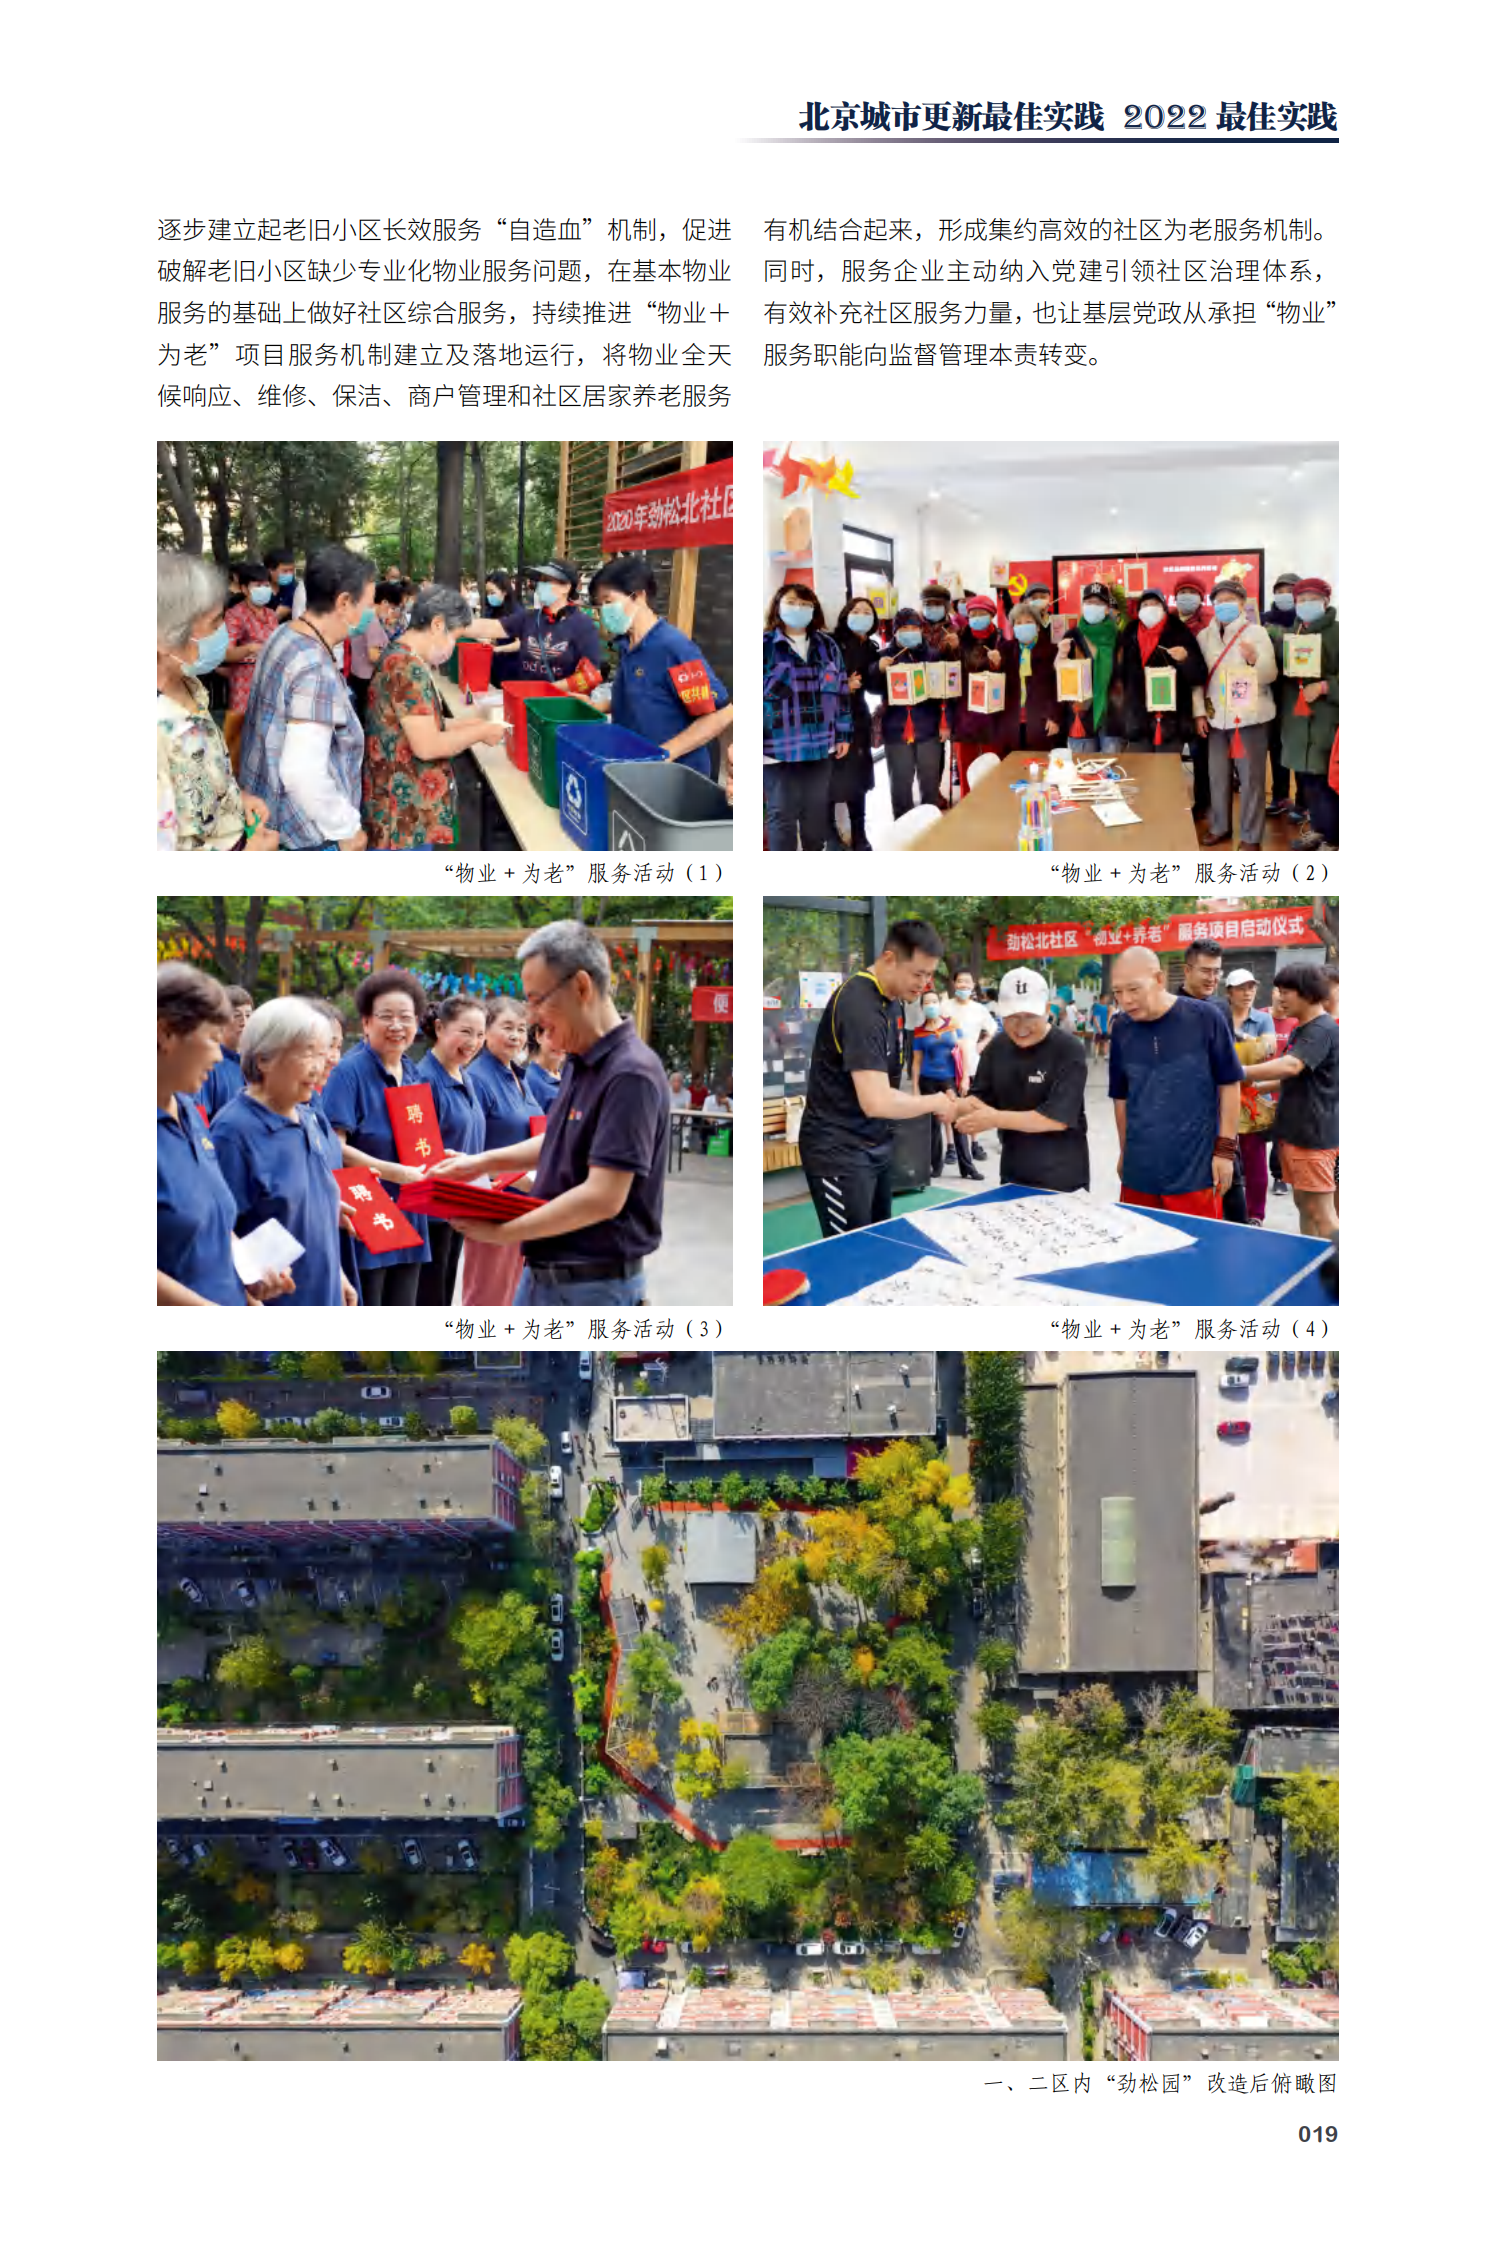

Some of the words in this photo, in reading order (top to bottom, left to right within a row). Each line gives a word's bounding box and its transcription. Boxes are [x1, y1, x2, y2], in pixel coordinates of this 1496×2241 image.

[799, 101, 1104, 131] 北京城市更新最佳实践
[1124, 104, 1206, 129] 2022
[1216, 101, 1337, 131] 最佳实践
[764, 218, 1322, 241] 有机结合起来，形成集约高效的社区为老服务机制。
[765, 259, 1321, 282] 同时，服务企业主动纳入党建引领社区治理体系，
[764, 301, 1335, 324] 有效补充社区服务力量，也让基层党政从承担“物业”
[764, 343, 1097, 366] 服务职能向监督管理本责转变。
[985, 2072, 1336, 2094] 一、二区内“劲松园”改造后俯瞰图
[1299, 2126, 1337, 2142] 019
